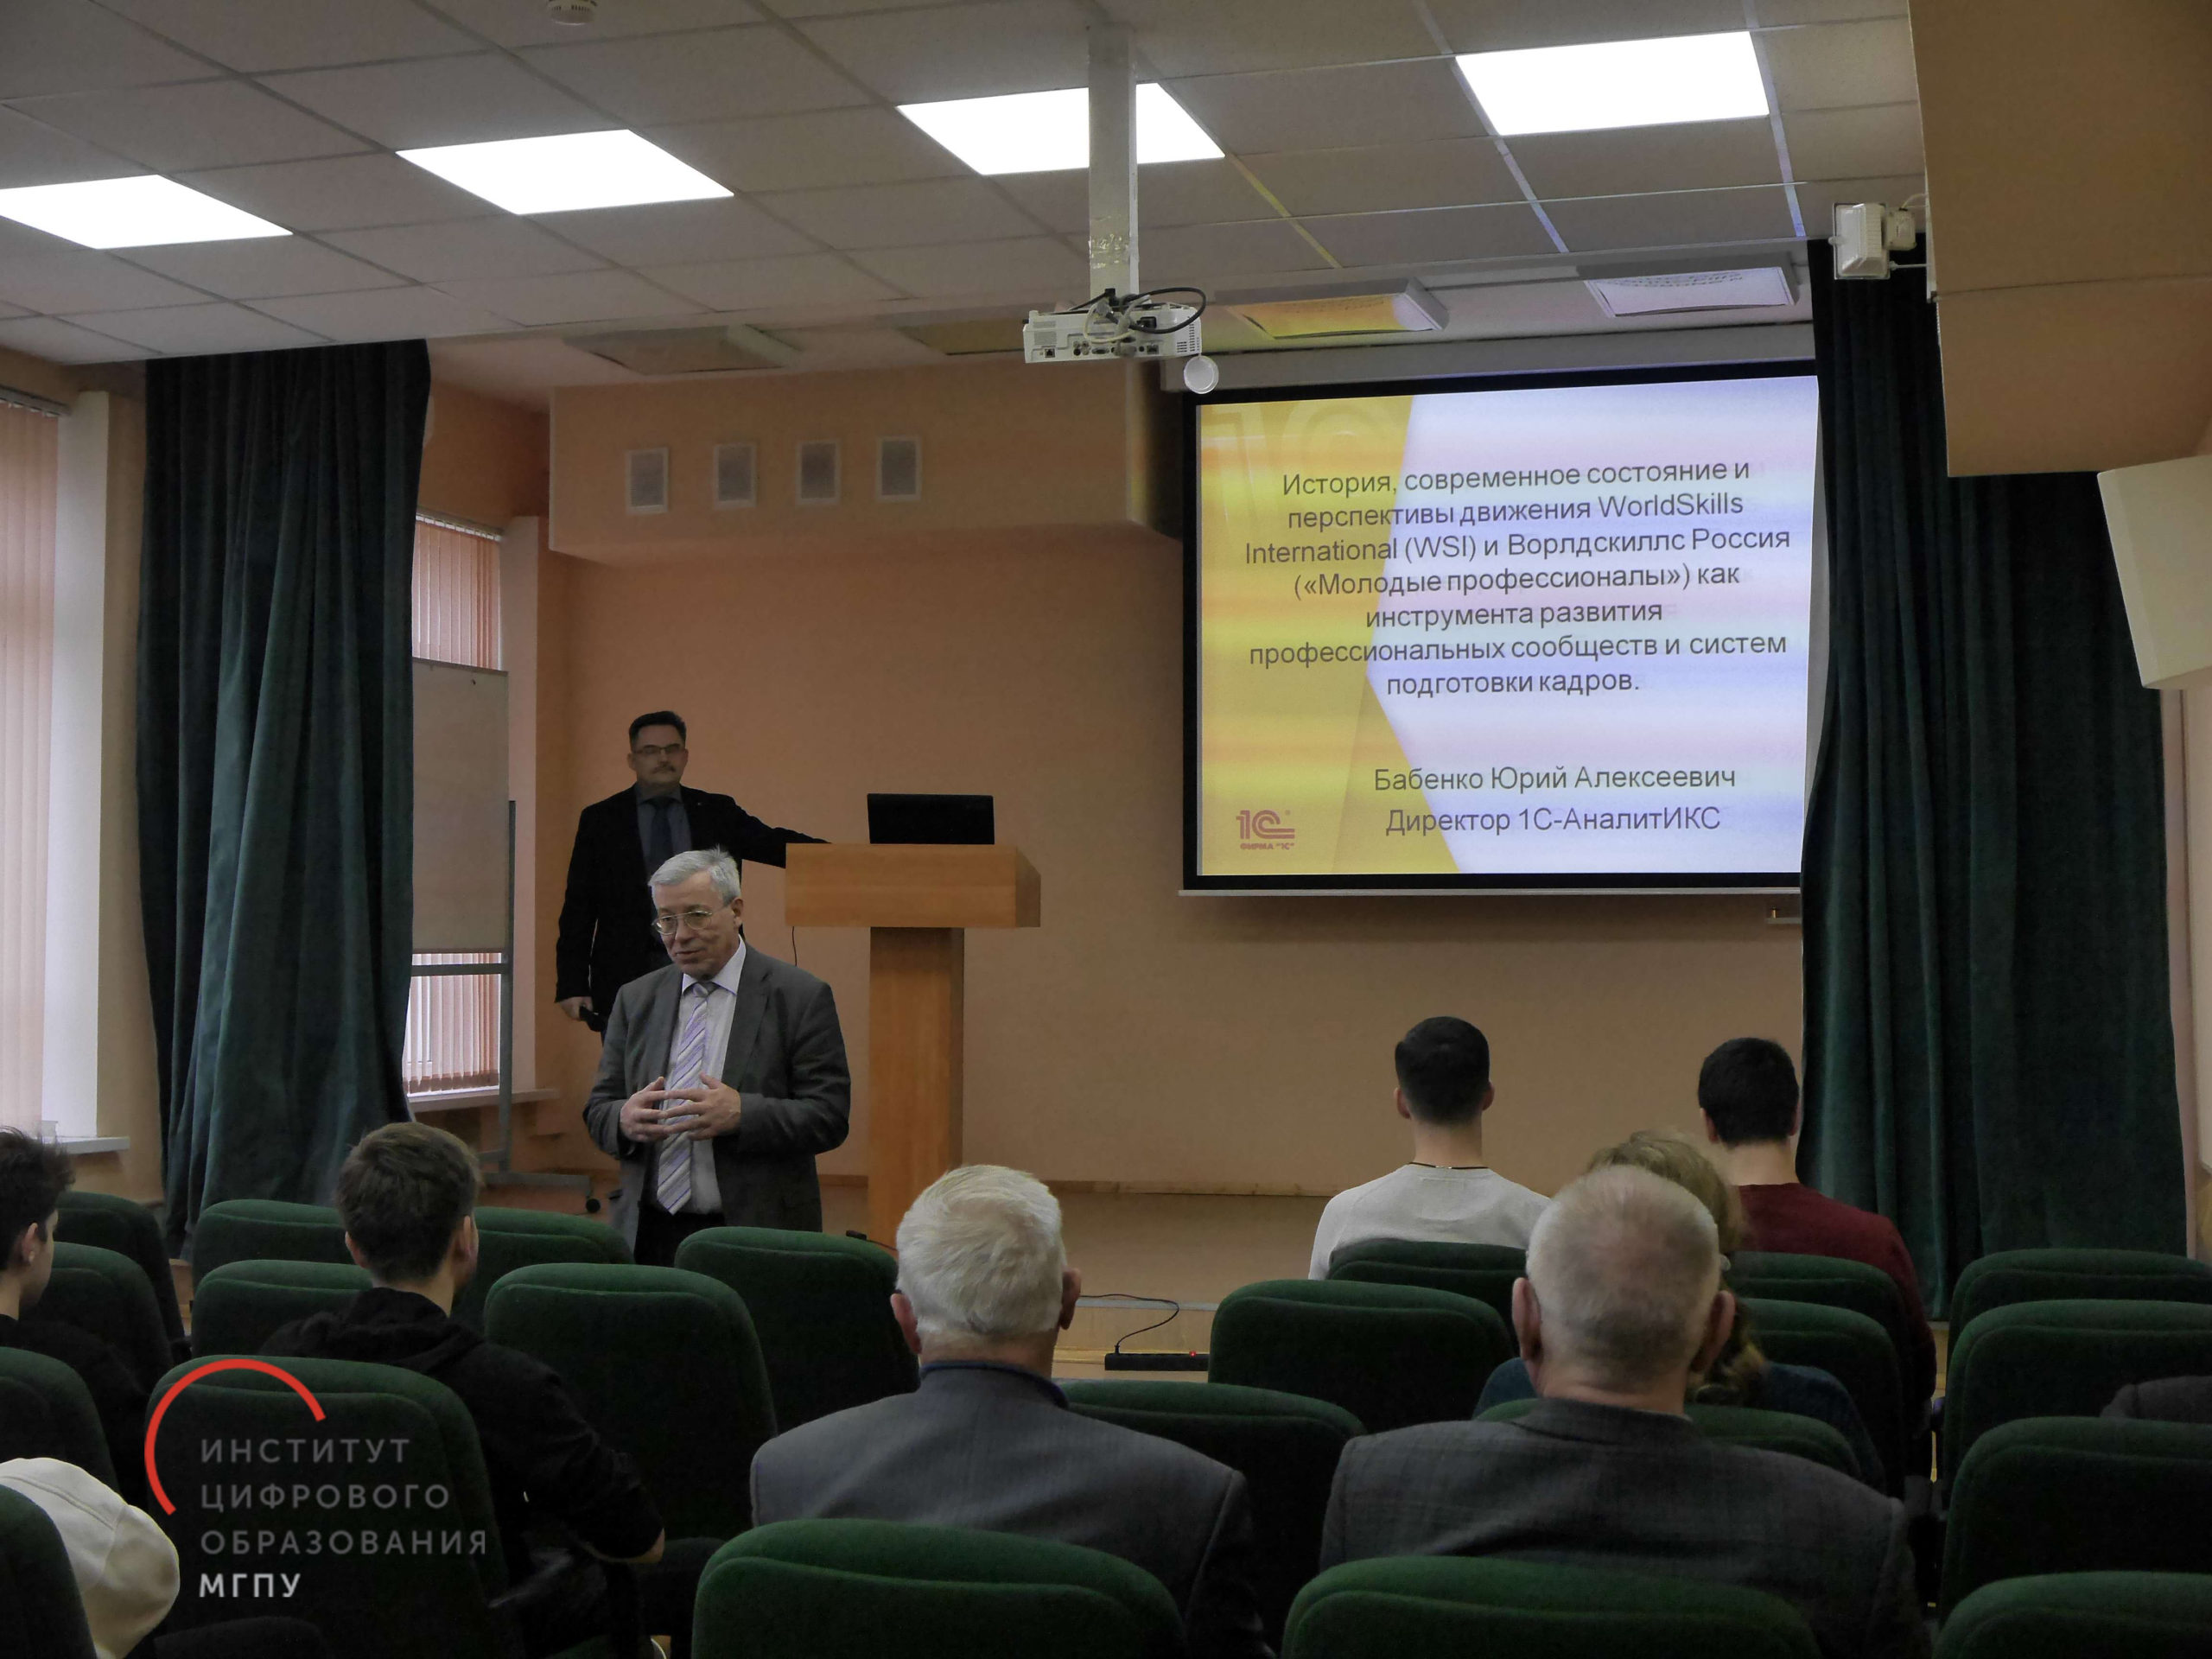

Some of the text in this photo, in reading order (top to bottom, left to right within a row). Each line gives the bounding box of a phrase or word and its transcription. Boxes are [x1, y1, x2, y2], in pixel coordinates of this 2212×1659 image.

[1283, 462, 1750, 500] История, современное состояние и
[1288, 492, 1744, 533] перспективы движения WorldSkills
[1246, 527, 1790, 564] International (WSI) и Ворлдскиллс Россия
[1294, 563, 1740, 601] («Молодые профессионалы») как
[1366, 603, 1662, 632] инструмента развития
[1250, 634, 1787, 670] профессиональных сообществ и систем
[1387, 673, 1641, 699] подготовки кадров.
[1375, 765, 1735, 793] Бабенко Юрий Алексеевич
[1385, 809, 1510, 836] Директор
